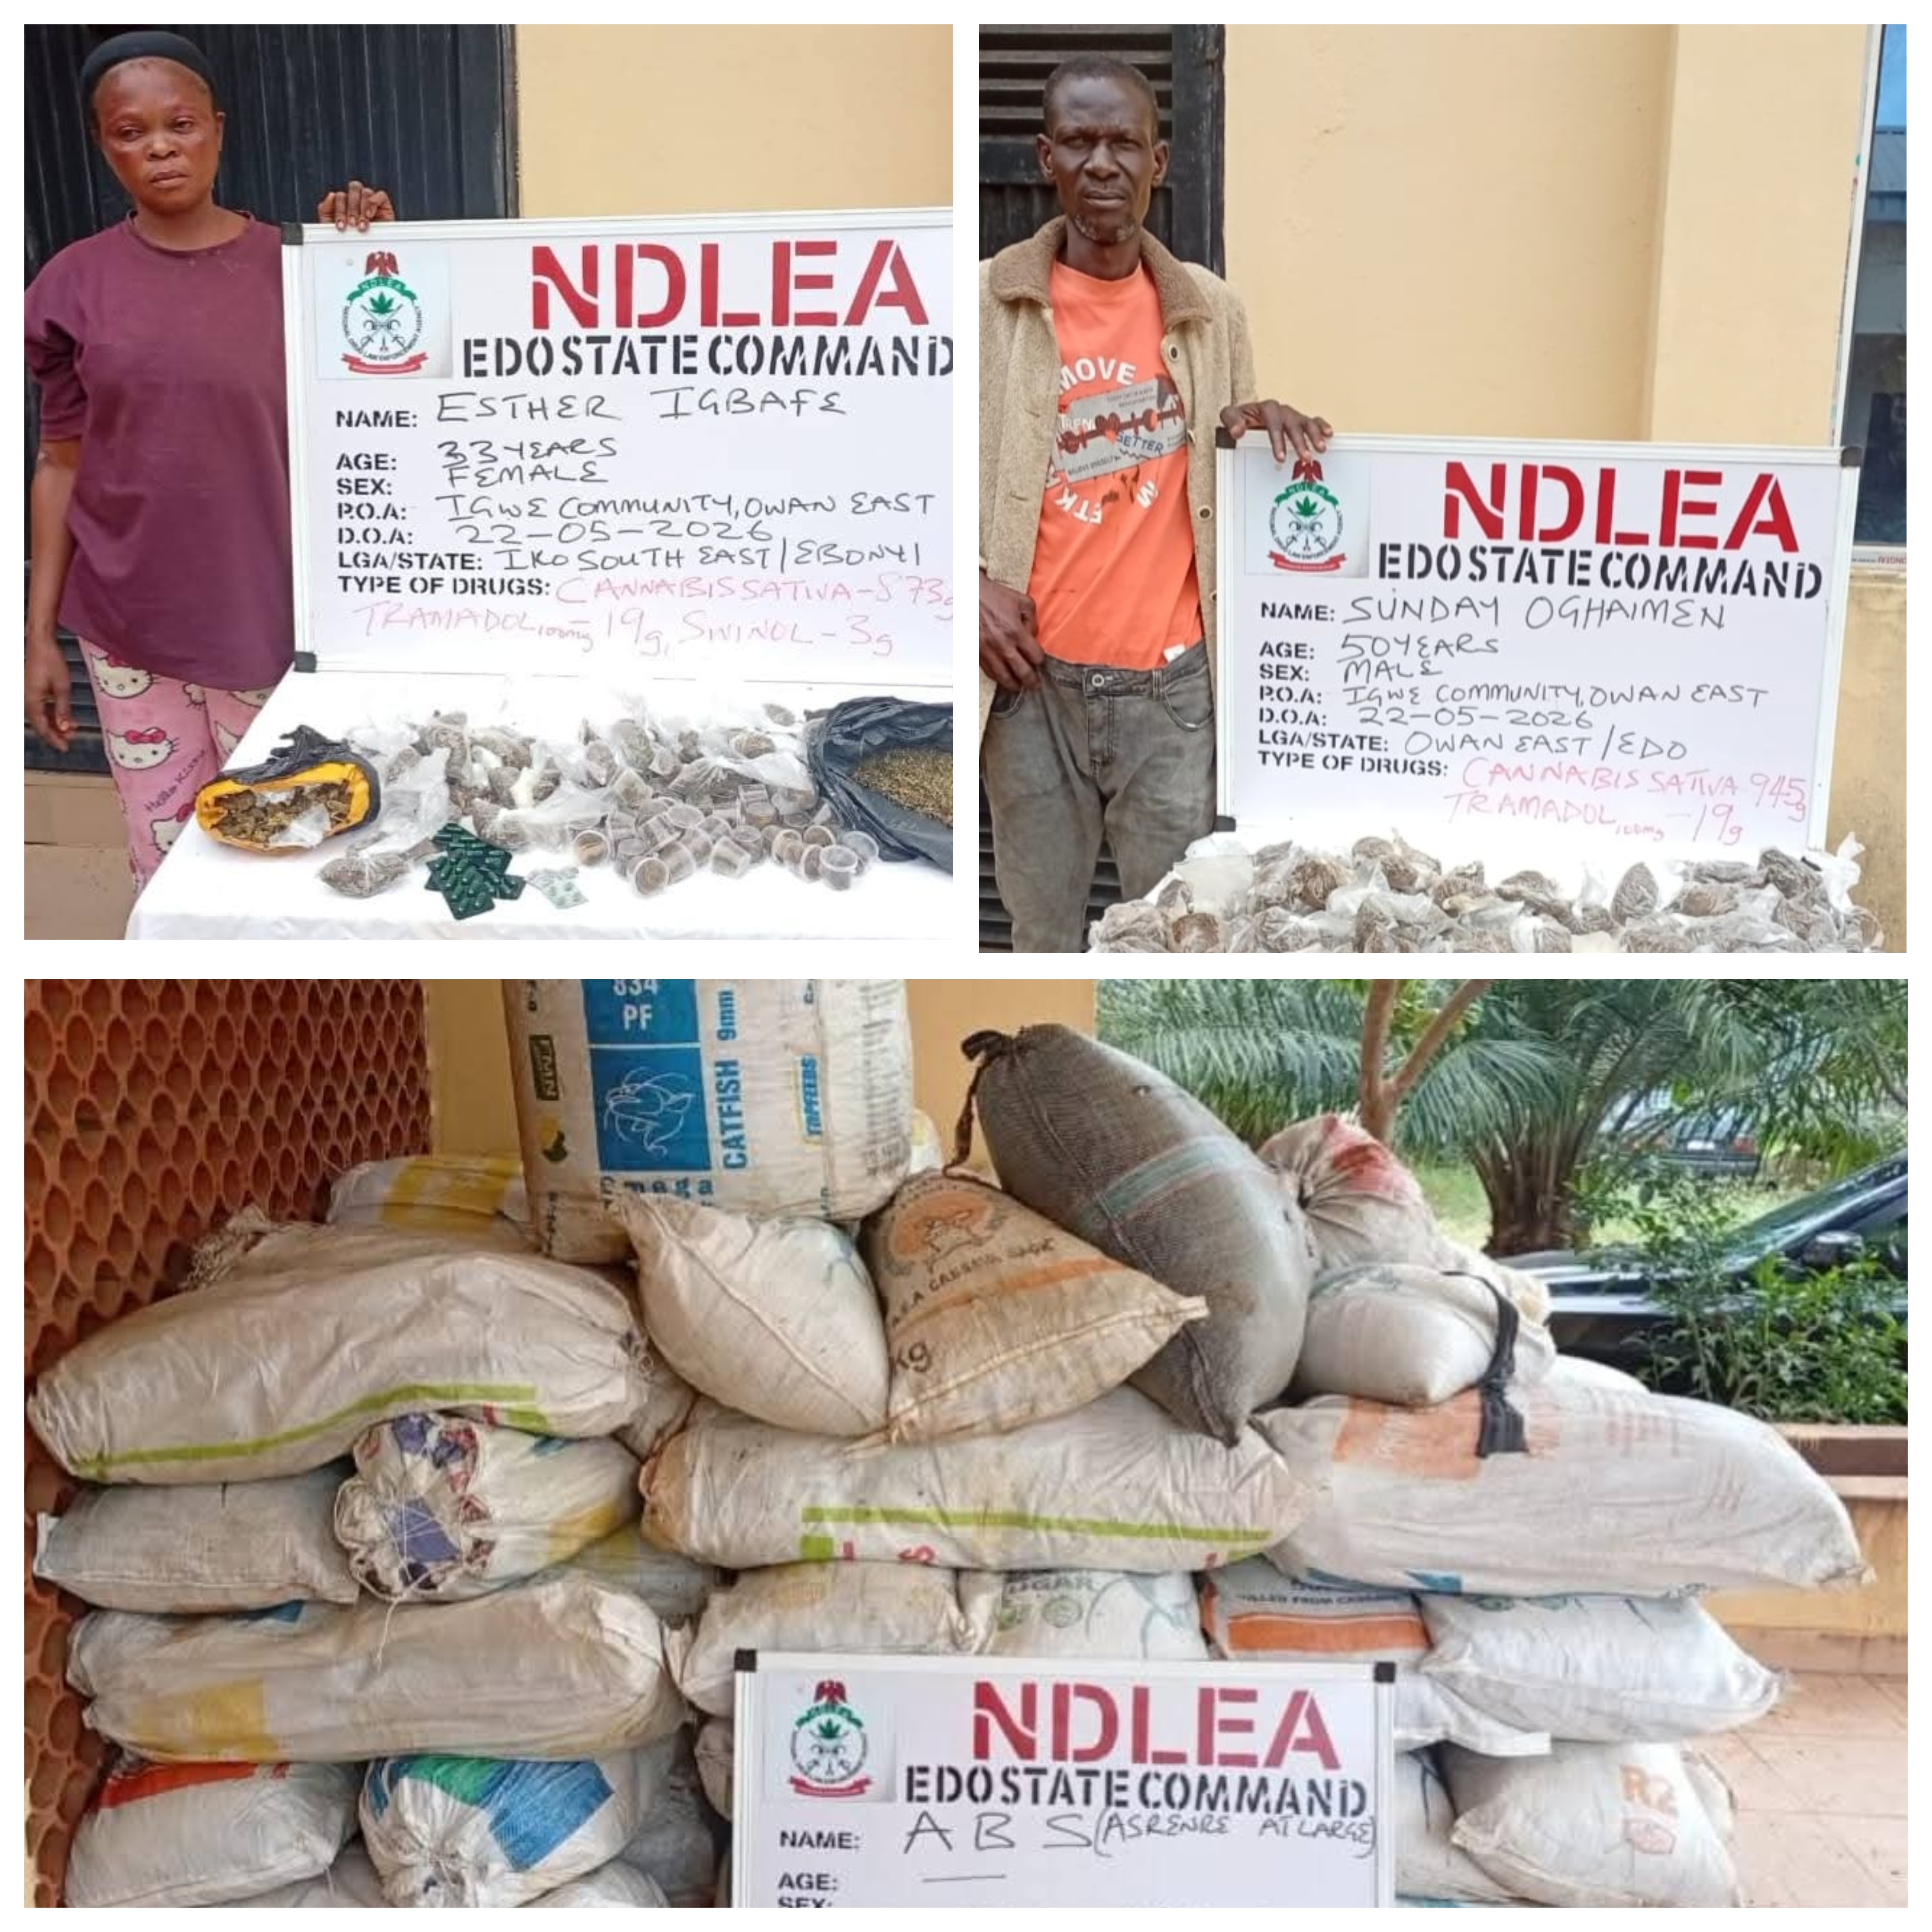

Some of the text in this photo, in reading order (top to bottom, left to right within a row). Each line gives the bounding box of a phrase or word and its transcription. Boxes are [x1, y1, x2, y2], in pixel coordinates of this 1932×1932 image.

[532, 240, 930, 330] NDLEA
[437, 387, 846, 422] ESTHER IGBAFE
[336, 410, 417, 428] NAME:
[336, 453, 397, 470] AGE:
[449, 461, 608, 487] FEMALE
[336, 478, 392, 495] SEX:
[337, 502, 406, 519] P.O.A:
[435, 495, 547, 521] IGWE
[850, 492, 935, 515] EAST
[1443, 461, 1799, 552] NDLEA
[337, 527, 413, 545] D.O.A:
[456, 520, 772, 544] 22-05-2026
[337, 551, 483, 571] LGA/STATE:
[338, 575, 550, 596] TYPE OF DRUGS:
[1261, 602, 1335, 622] NAME:
[1342, 595, 1725, 630] SUNDAY OGHAIMEN
[1259, 641, 1315, 660] AGE:
[1259, 664, 1309, 682] SEX:
[1343, 659, 1442, 684] MALE
[1259, 685, 1322, 704] P.O.A:
[1343, 685, 1421, 707] IGWE
[1691, 684, 1770, 708] EAST
[1259, 708, 1327, 726] D.O.A:
[1359, 706, 1593, 729] 22-05-2026
[1258, 729, 1389, 752] LGA/STATE:
[1405, 731, 1504, 755] OWAN
[1257, 750, 1449, 777] TYPE OF DRUGS:
[623, 1004, 653, 1030] PF
[715, 991, 746, 1170] CATFISH 9mm
[973, 1681, 1341, 1770] NDLEA
[779, 1831, 860, 1850] NAME:
[778, 1873, 839, 1891] AGE:
